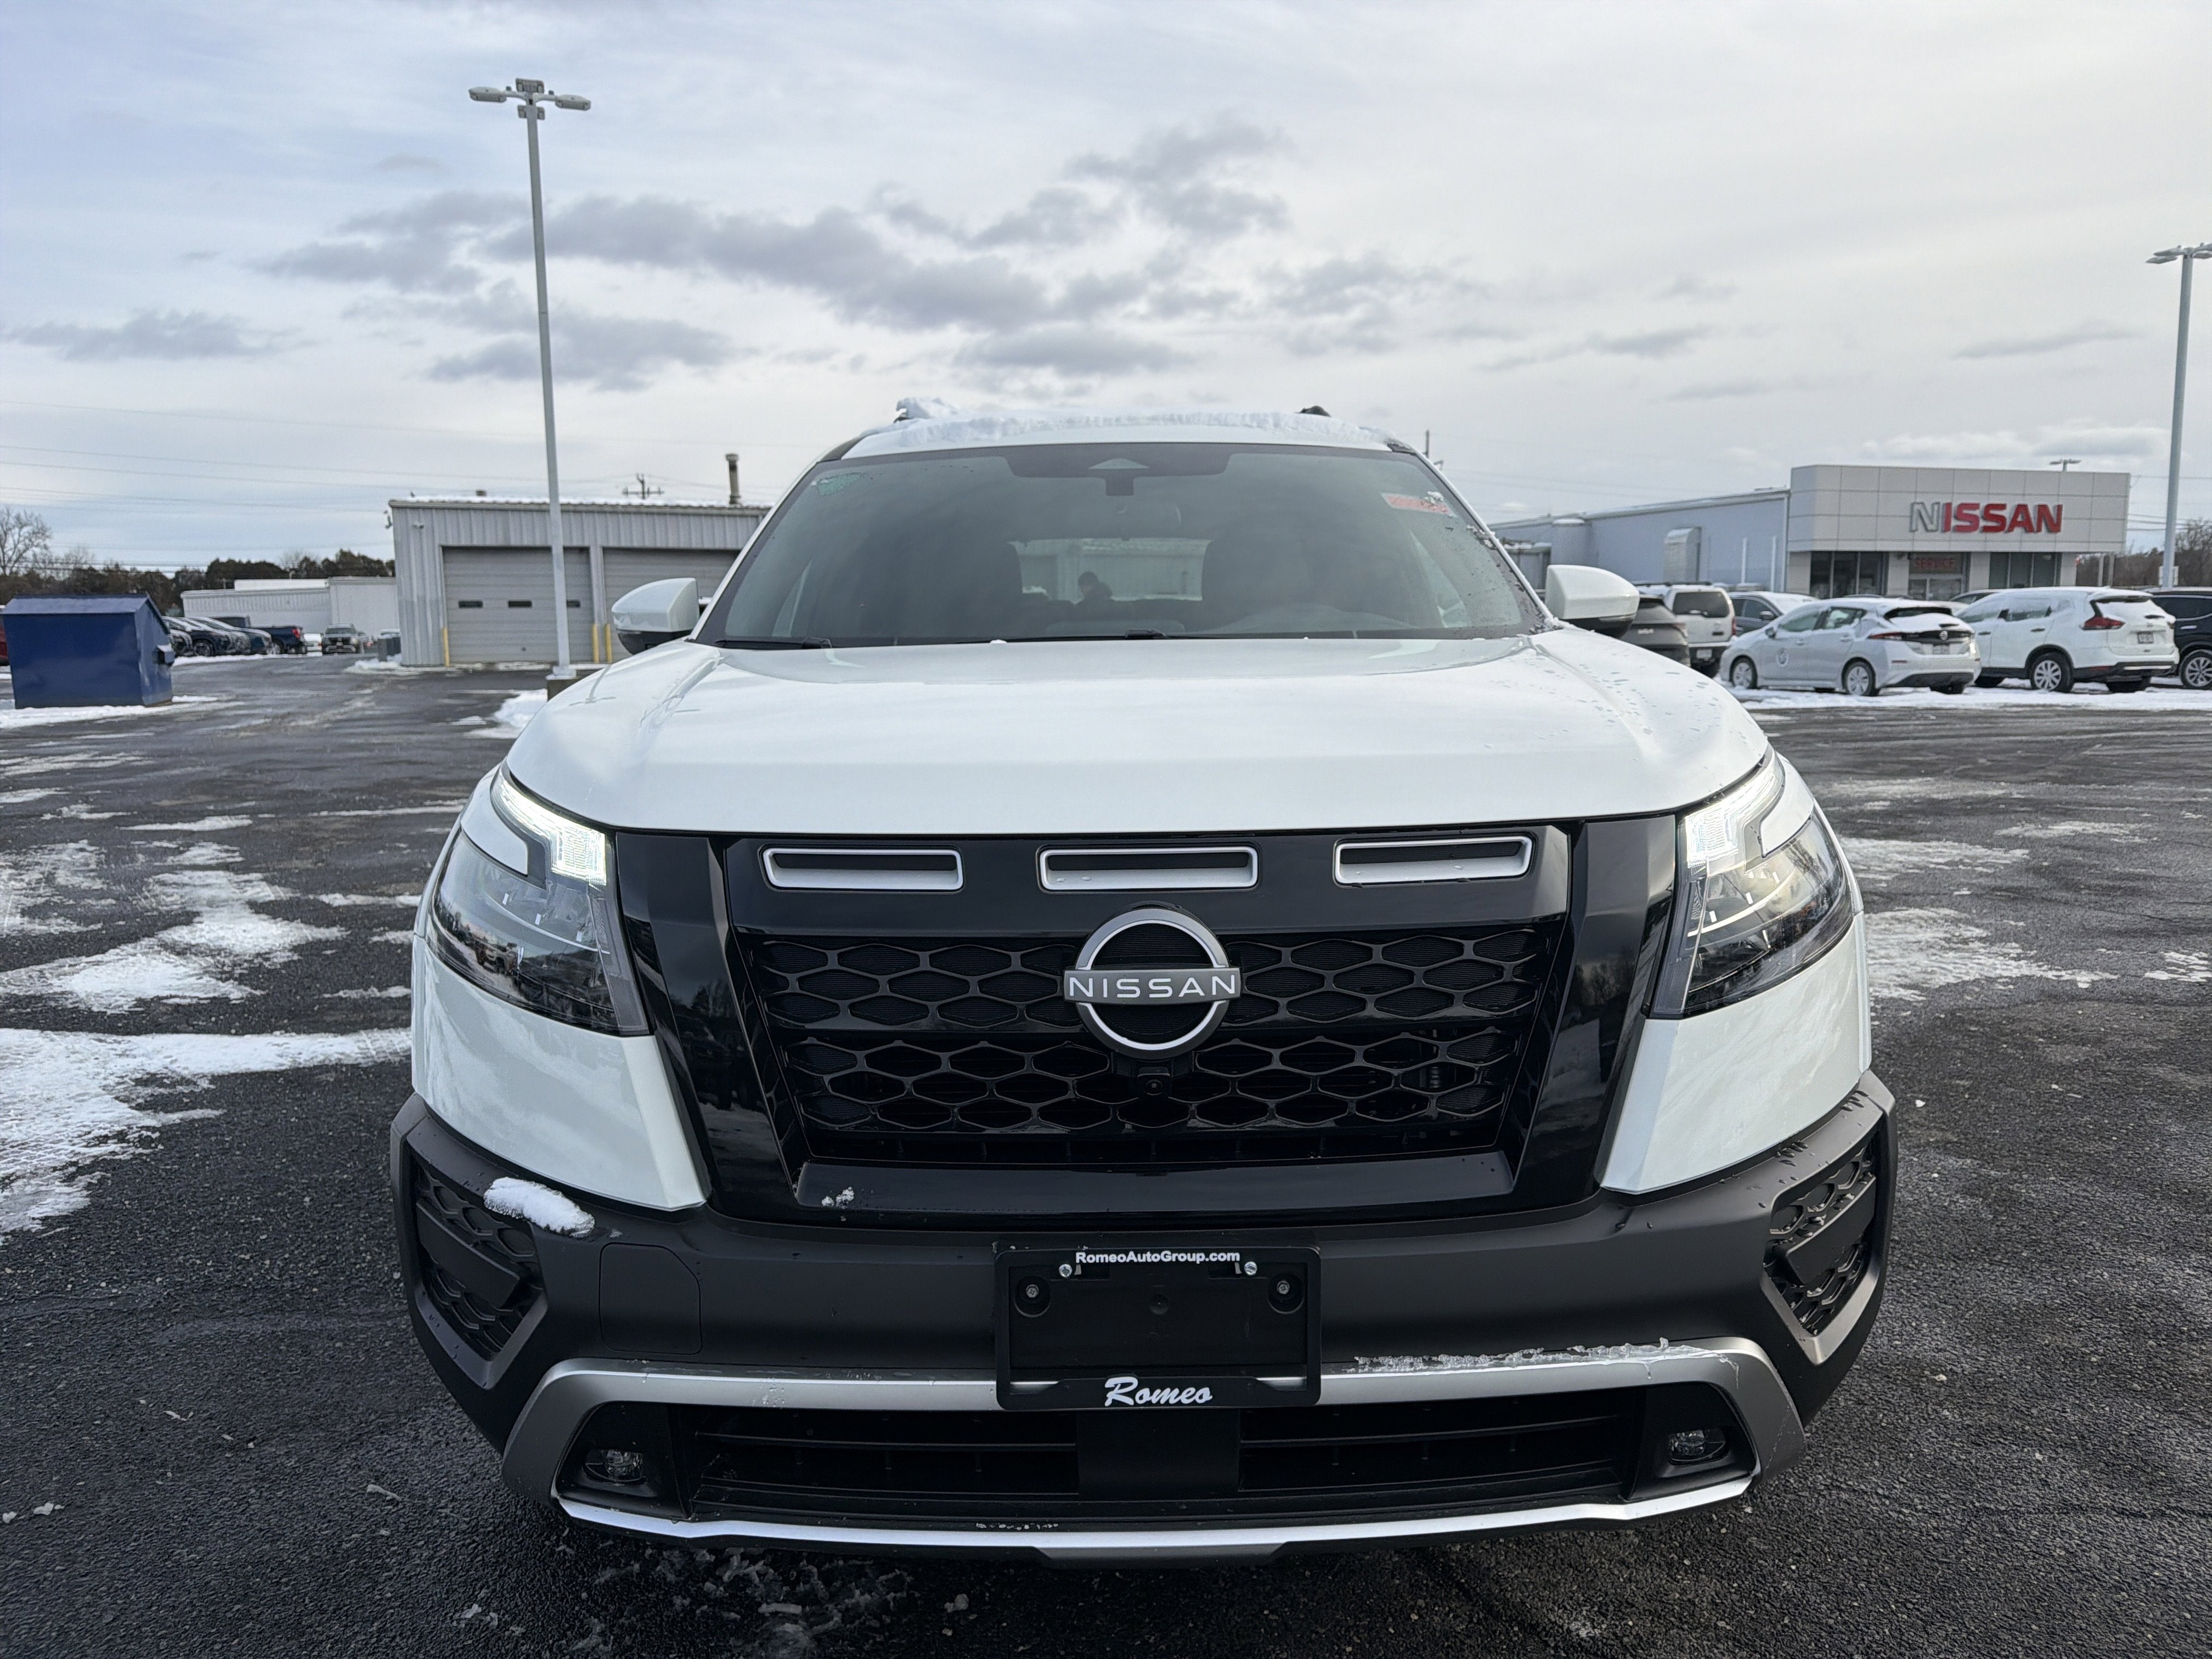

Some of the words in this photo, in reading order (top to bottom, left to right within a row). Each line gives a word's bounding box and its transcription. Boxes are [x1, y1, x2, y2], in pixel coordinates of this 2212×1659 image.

[1909, 501, 2063, 533] NISSAN
[1069, 975, 1235, 998] NISSAN
[1076, 1251, 1240, 1263] RomeoAutoGroup.com
[1104, 1376, 1213, 1407] Romeo
